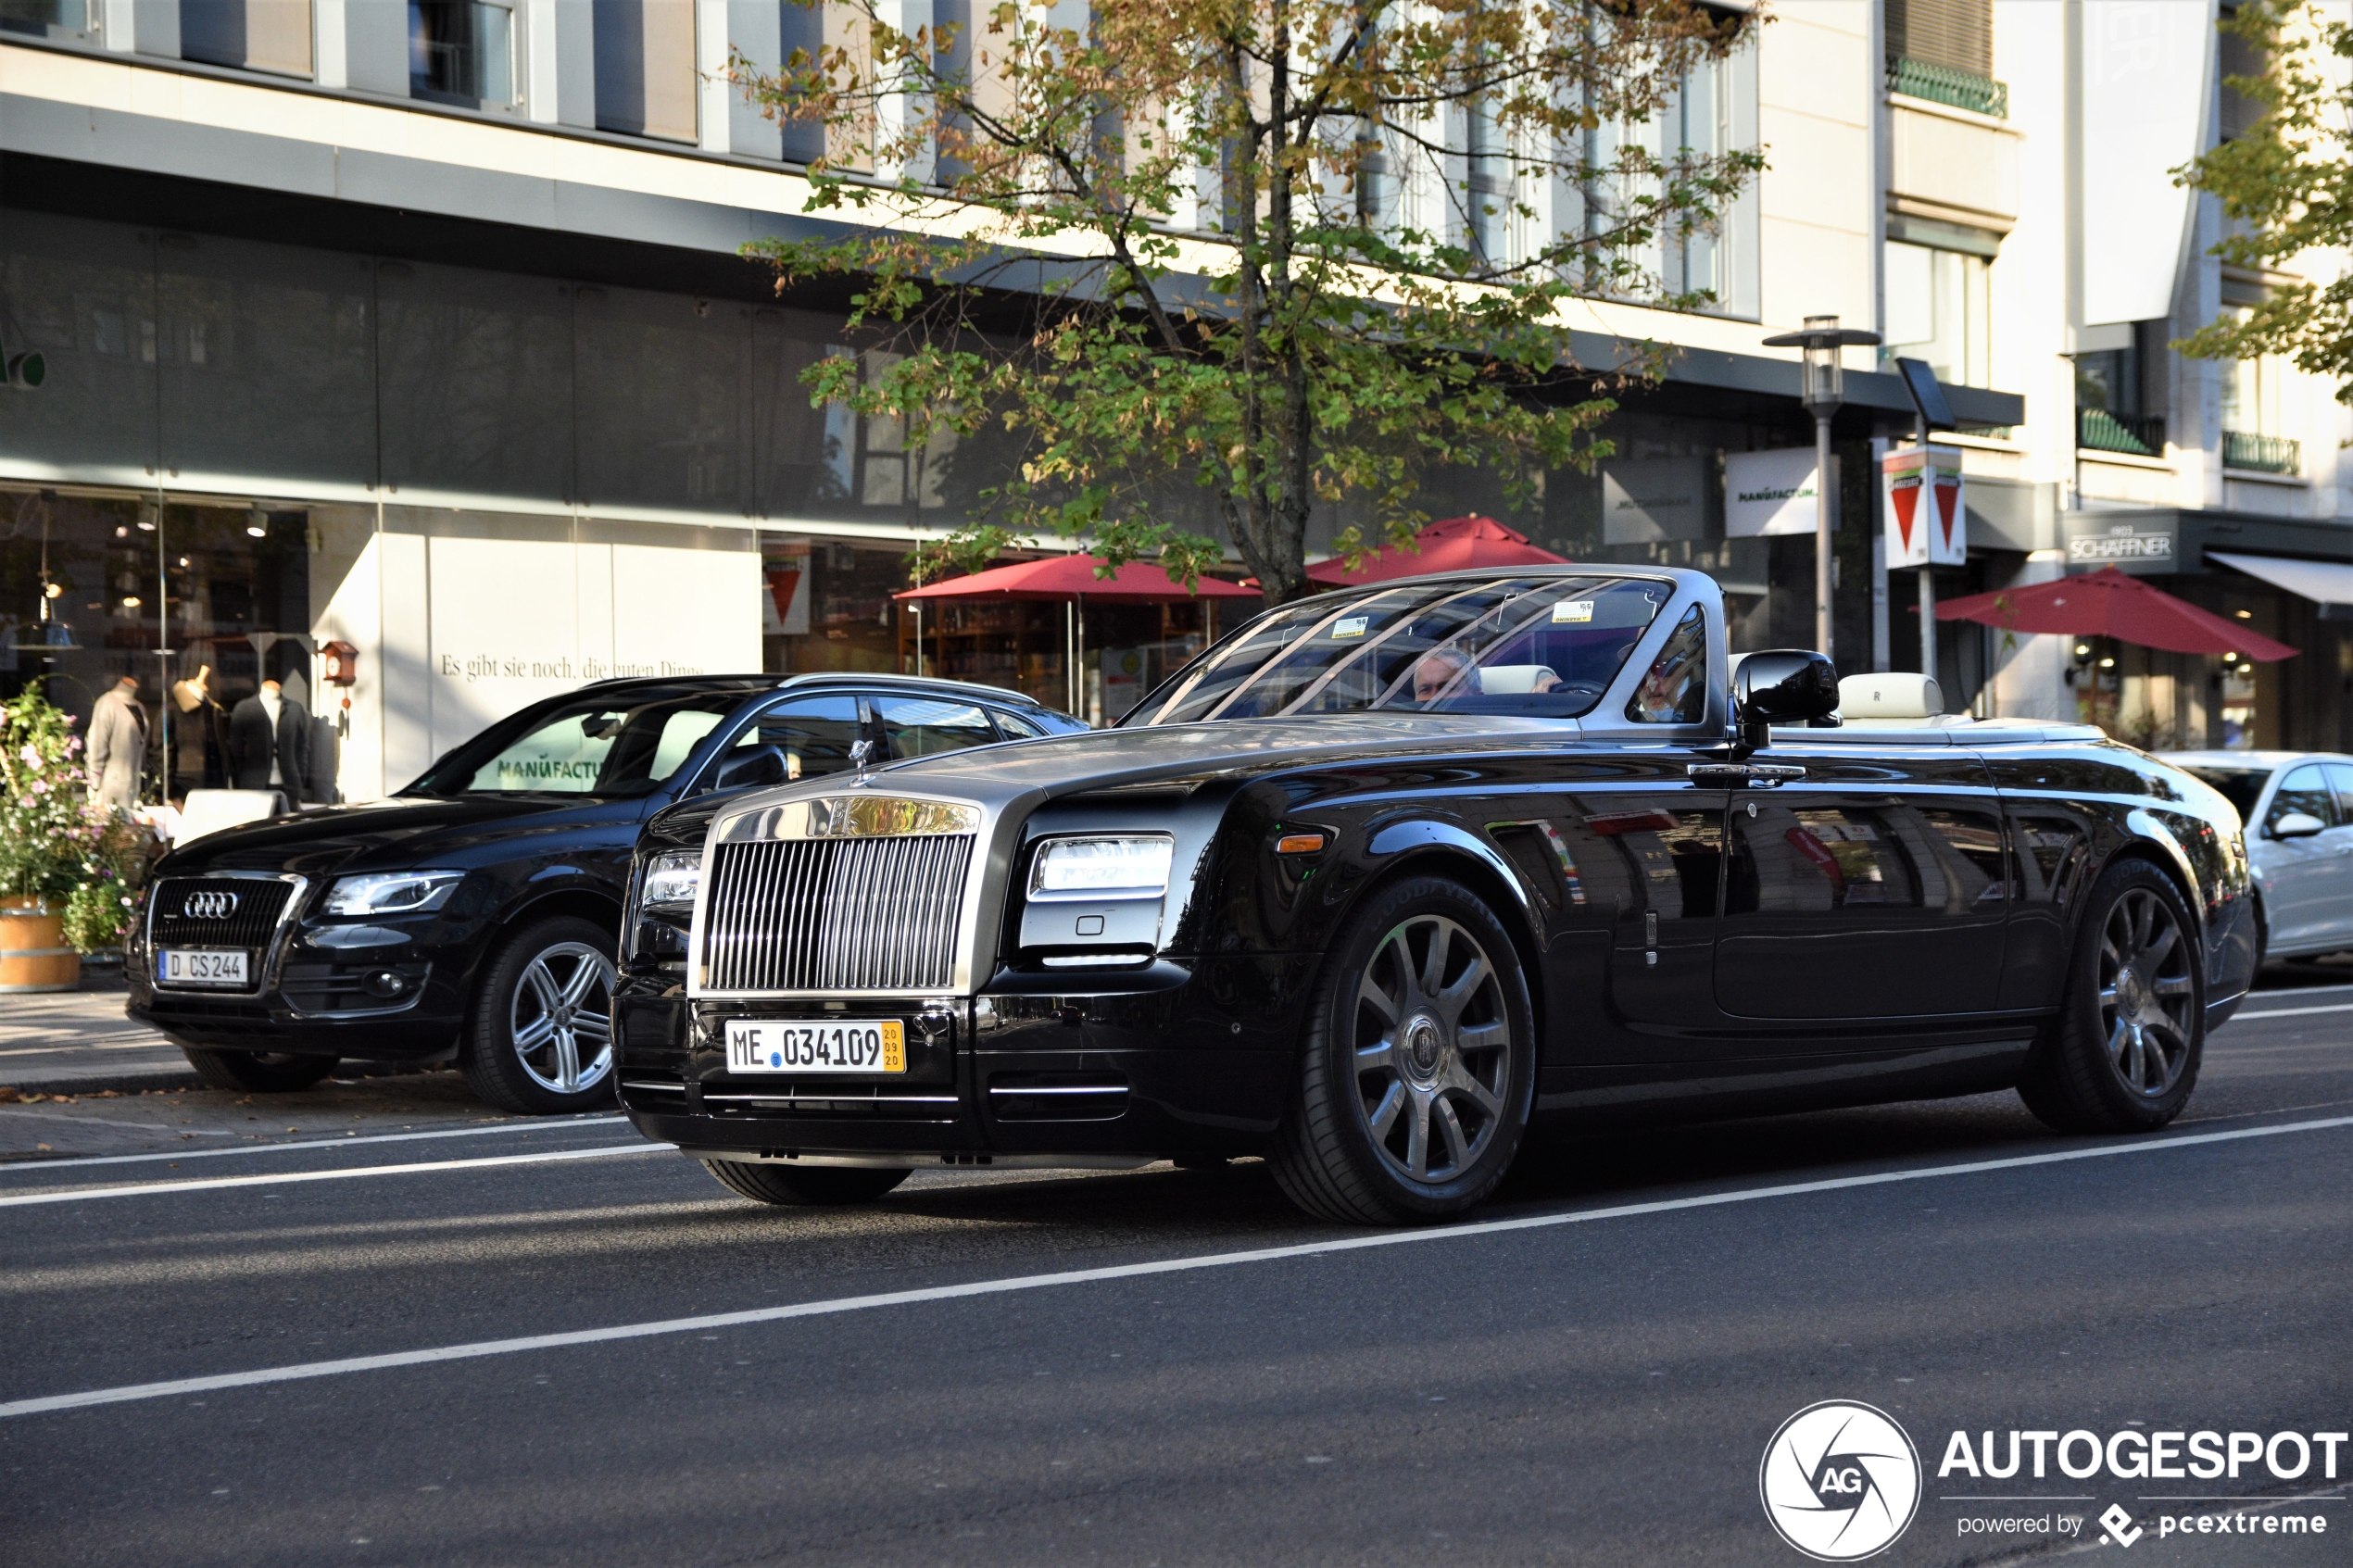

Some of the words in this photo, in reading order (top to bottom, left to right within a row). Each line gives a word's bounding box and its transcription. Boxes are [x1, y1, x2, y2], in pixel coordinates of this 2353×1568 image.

[2109, 0, 2159, 83] ER
[441, 654, 460, 677] Es
[467, 654, 497, 683] gibt
[503, 658, 526, 678] sie
[533, 657, 576, 680] noch,
[583, 657, 607, 679] die
[171, 955, 181, 977] D
[190, 955, 209, 977] CS
[212, 956, 240, 978] 244
[884, 1028, 897, 1039] 20
[733, 1029, 764, 1065] ME
[783, 1028, 879, 1066] 034109
[885, 1042, 897, 1052] 09
[886, 1055, 898, 1066] 20
